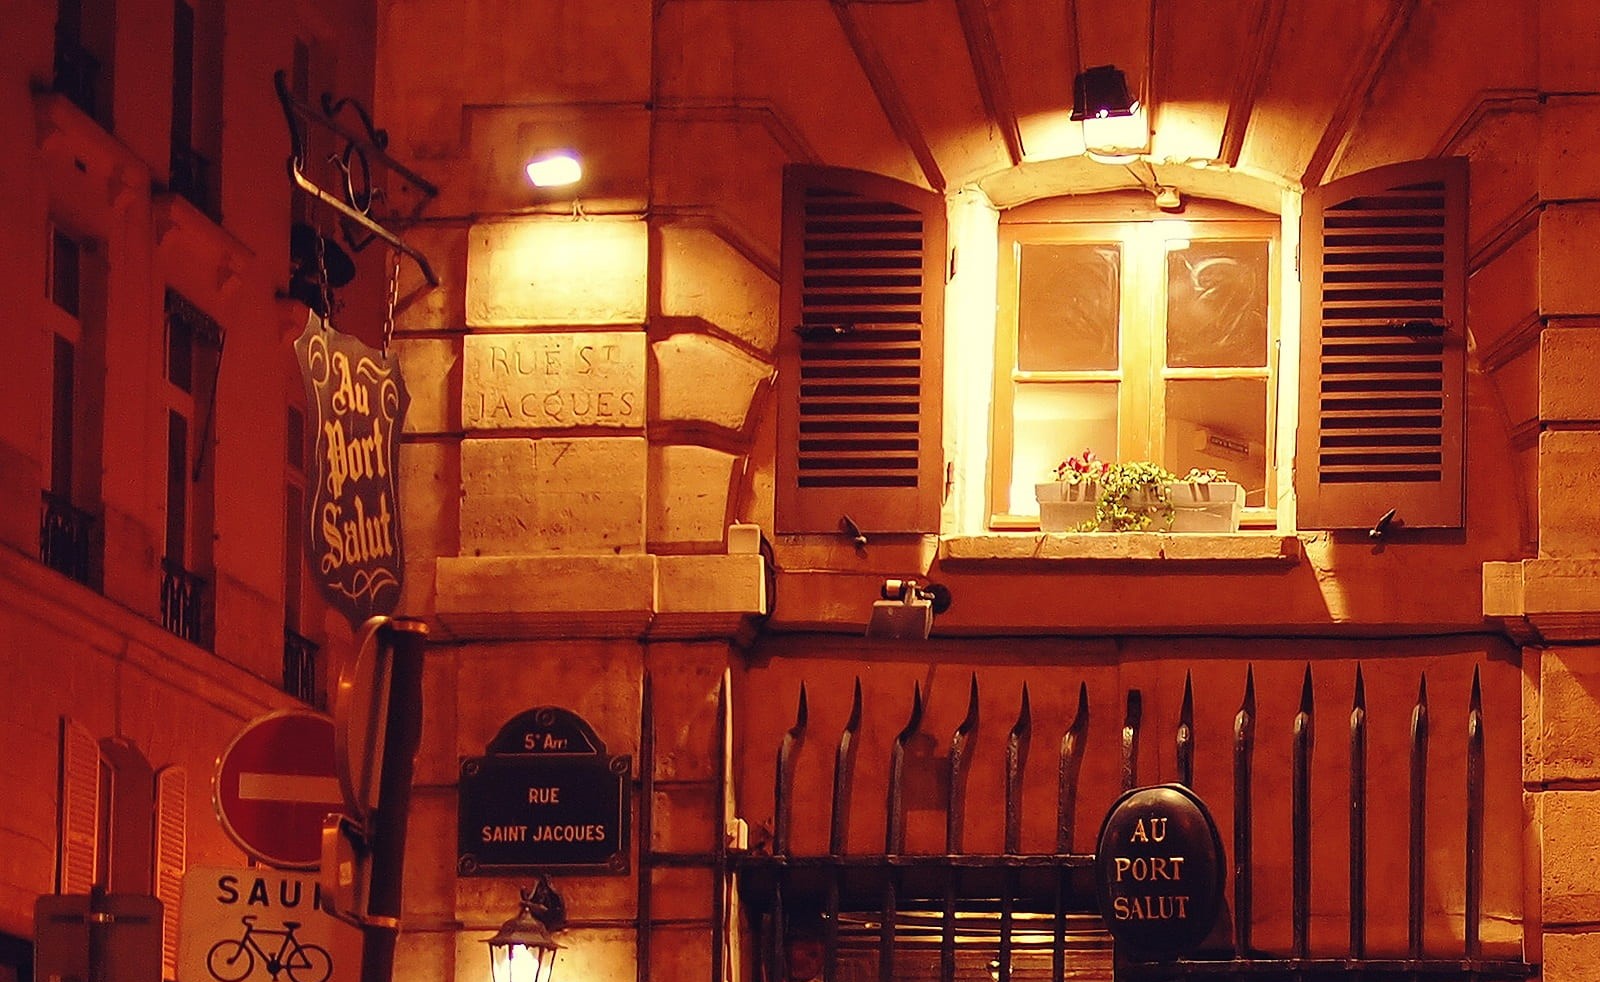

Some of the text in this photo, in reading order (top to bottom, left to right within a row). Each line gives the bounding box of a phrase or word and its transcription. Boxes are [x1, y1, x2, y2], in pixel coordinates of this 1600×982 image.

[490, 345, 562, 376] RUE
[332, 351, 370, 417] Au
[472, 390, 636, 423] JACQUES
[325, 417, 387, 500] Port
[321, 491, 394, 575] Salut
[529, 787, 560, 804] RUE
[482, 825, 606, 842] SAINT JACQUES
[1130, 817, 1168, 842] AU
[1114, 857, 1185, 881] PORT
[1113, 896, 1189, 920] SALUT
